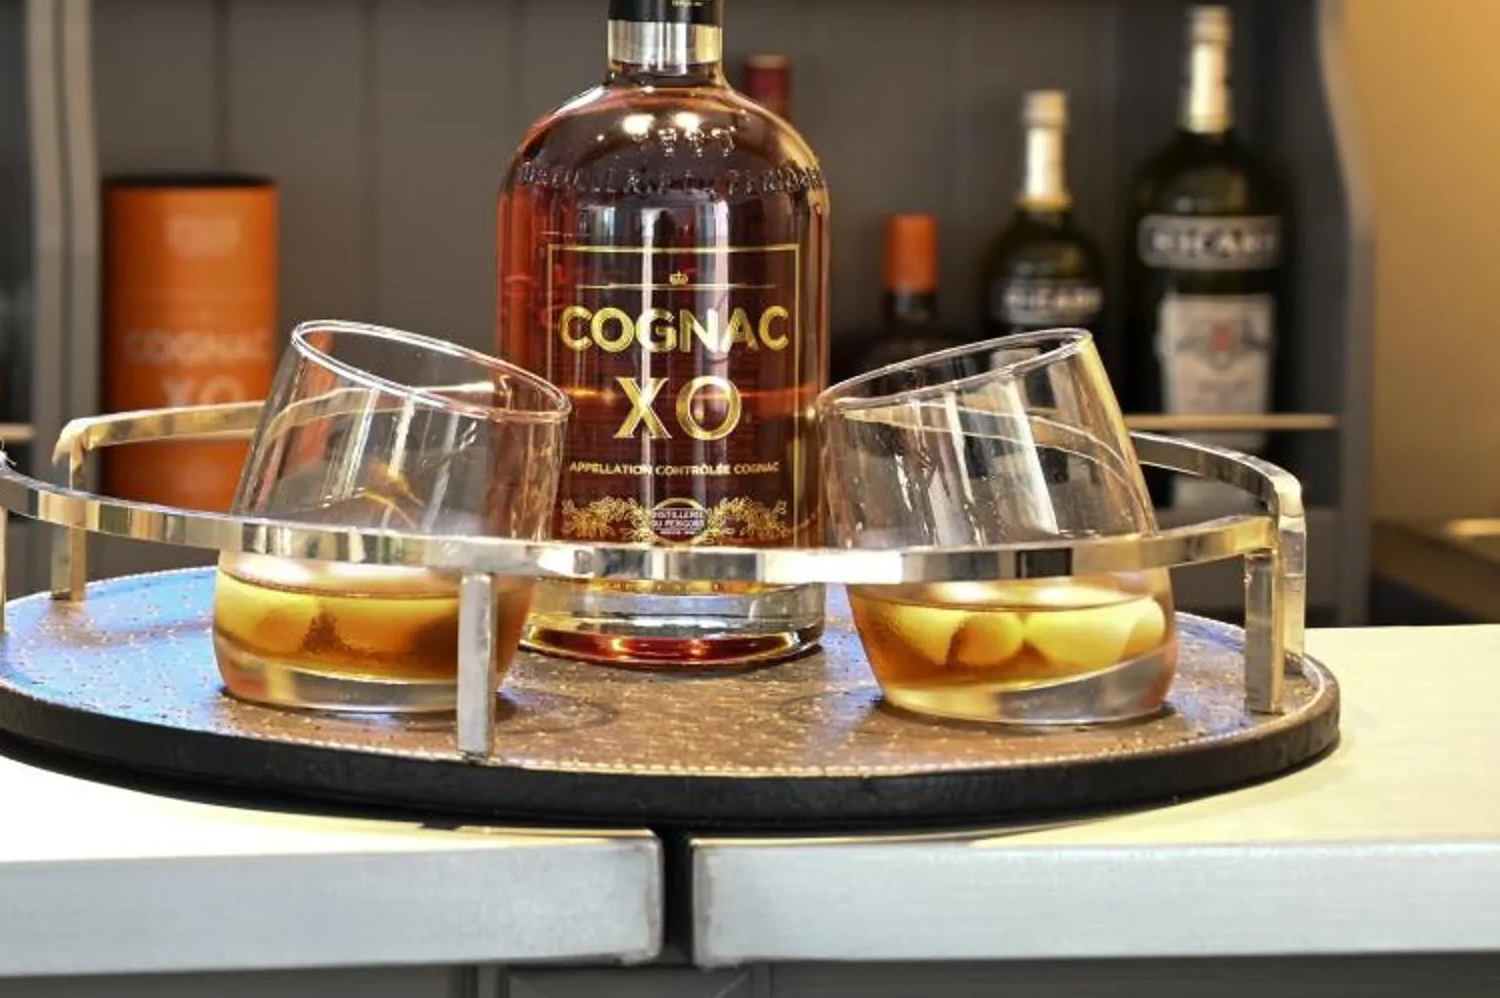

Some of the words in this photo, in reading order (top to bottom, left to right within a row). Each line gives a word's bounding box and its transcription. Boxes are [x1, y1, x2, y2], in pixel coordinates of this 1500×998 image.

[558, 304, 790, 353] COGNAC
[612, 375, 743, 441] XO
[568, 461, 652, 476] APPELLATION
[733, 460, 780, 475] COGNAC
